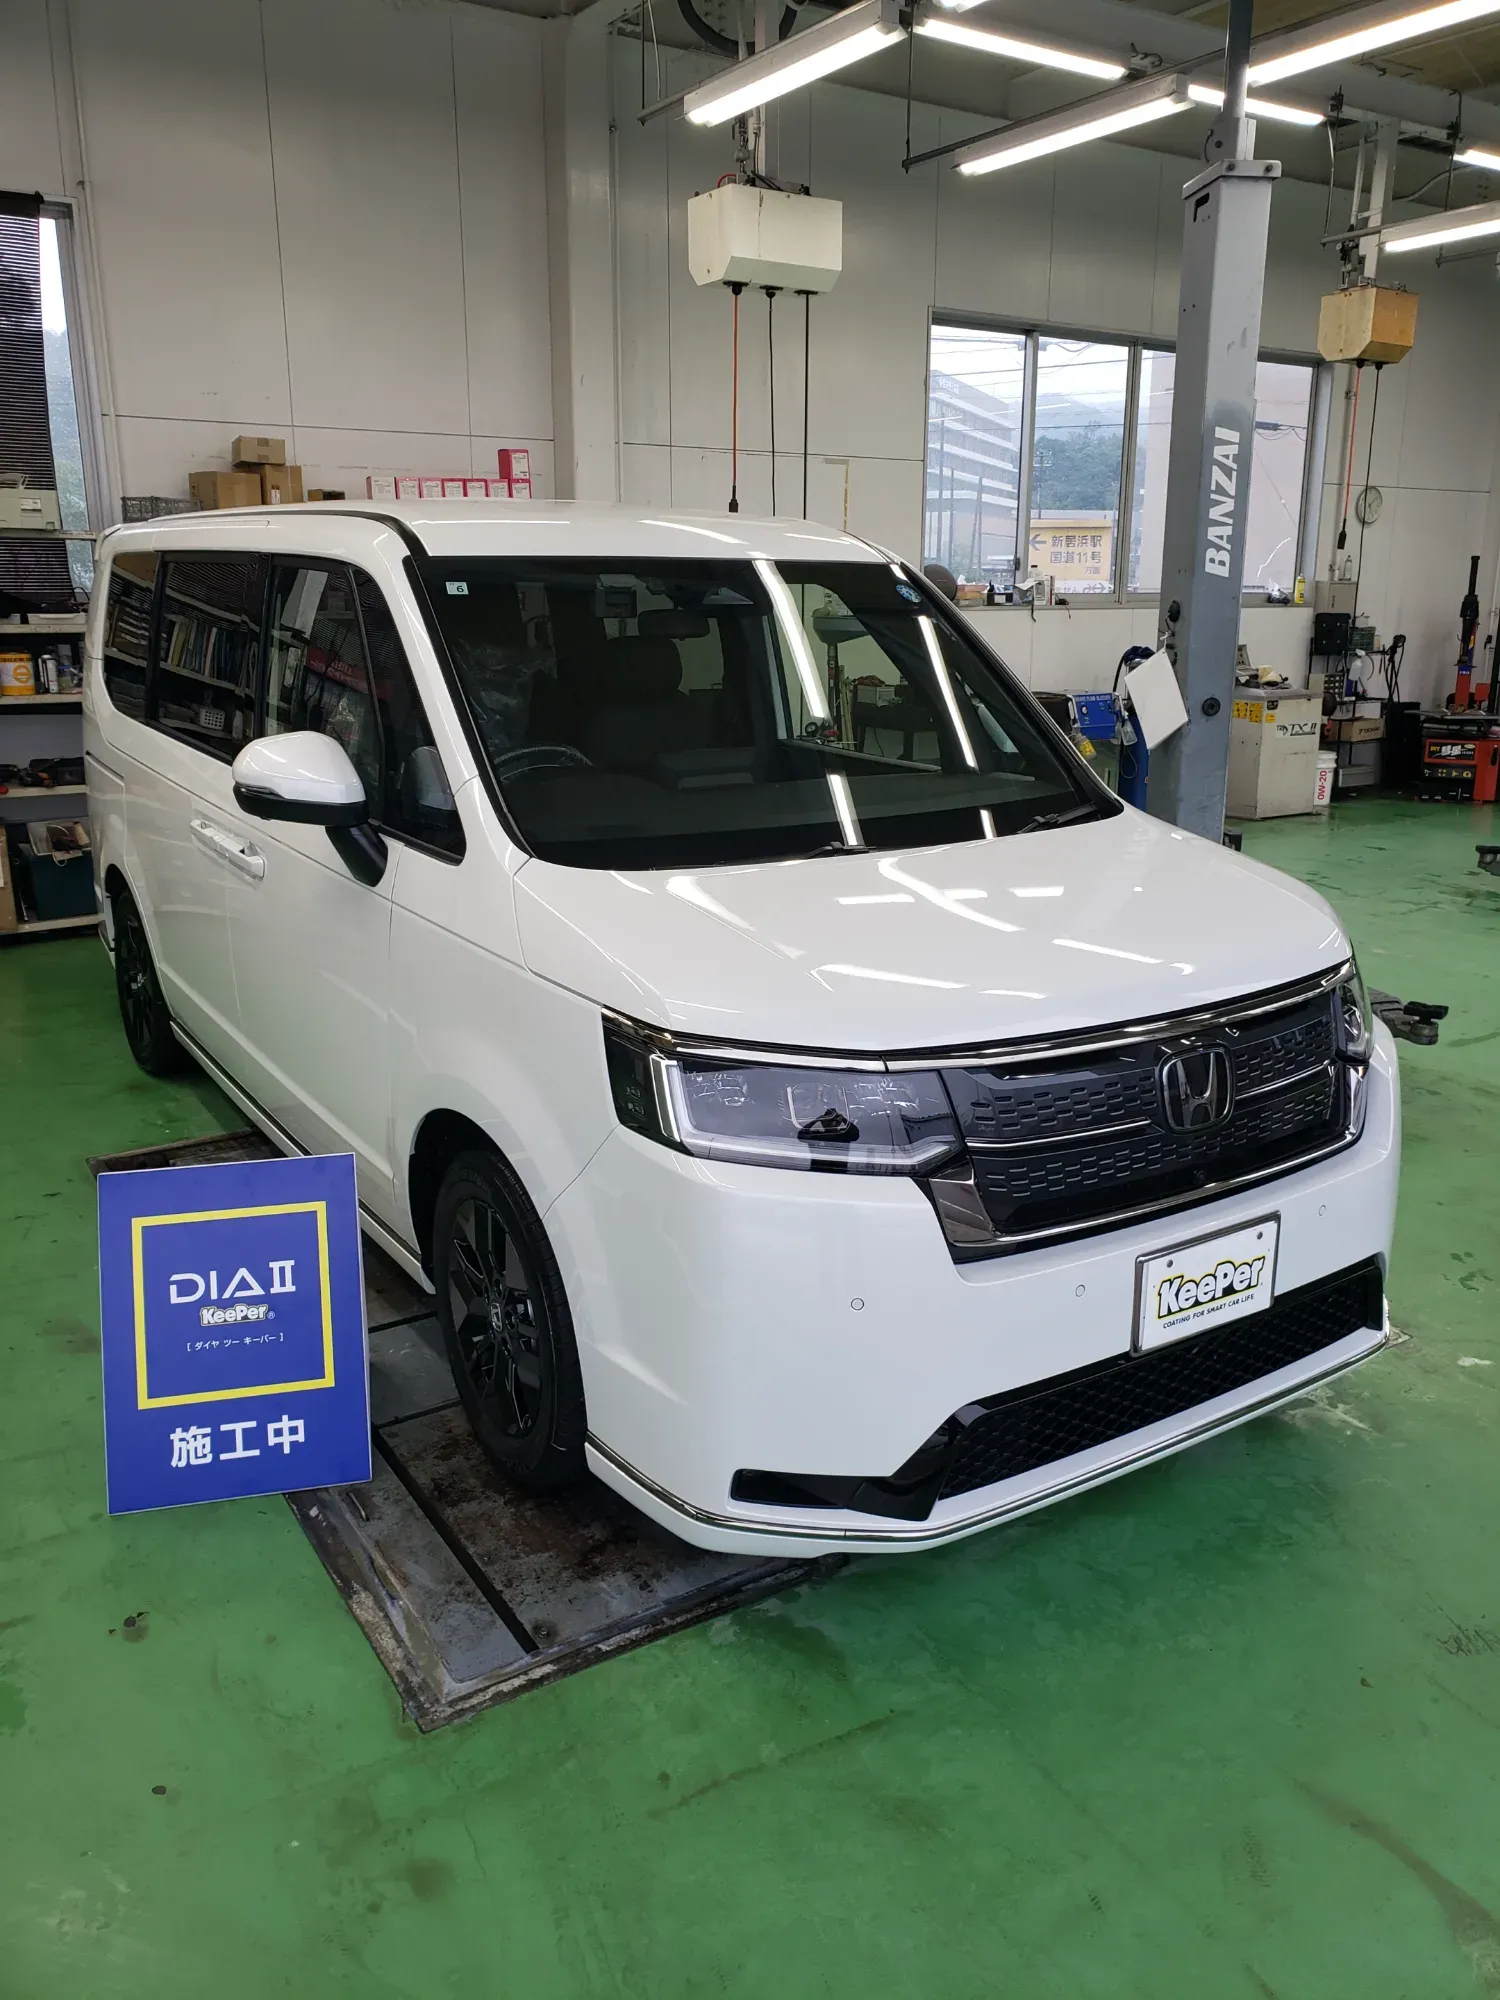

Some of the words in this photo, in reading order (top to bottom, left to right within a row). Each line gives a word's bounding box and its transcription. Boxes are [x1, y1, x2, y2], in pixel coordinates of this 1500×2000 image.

[1204, 426, 1240, 578] BANZAI
[1051, 535, 1102, 548] 新居浜駅
[1050, 551, 1102, 564] 国道11号
[456, 585, 465, 593] 6
[1317, 770, 1328, 801] 0W-20
[1157, 1254, 1266, 1319] KeePer
[200, 1303, 268, 1326] KeePer
[1163, 1315, 1191, 1329] COATING
[1192, 1308, 1205, 1320] FOR
[1206, 1302, 1227, 1315] SMART
[1228, 1298, 1240, 1307] CAR
[1241, 1293, 1255, 1303] LIFE
[169, 1414, 306, 1468] 施工中
